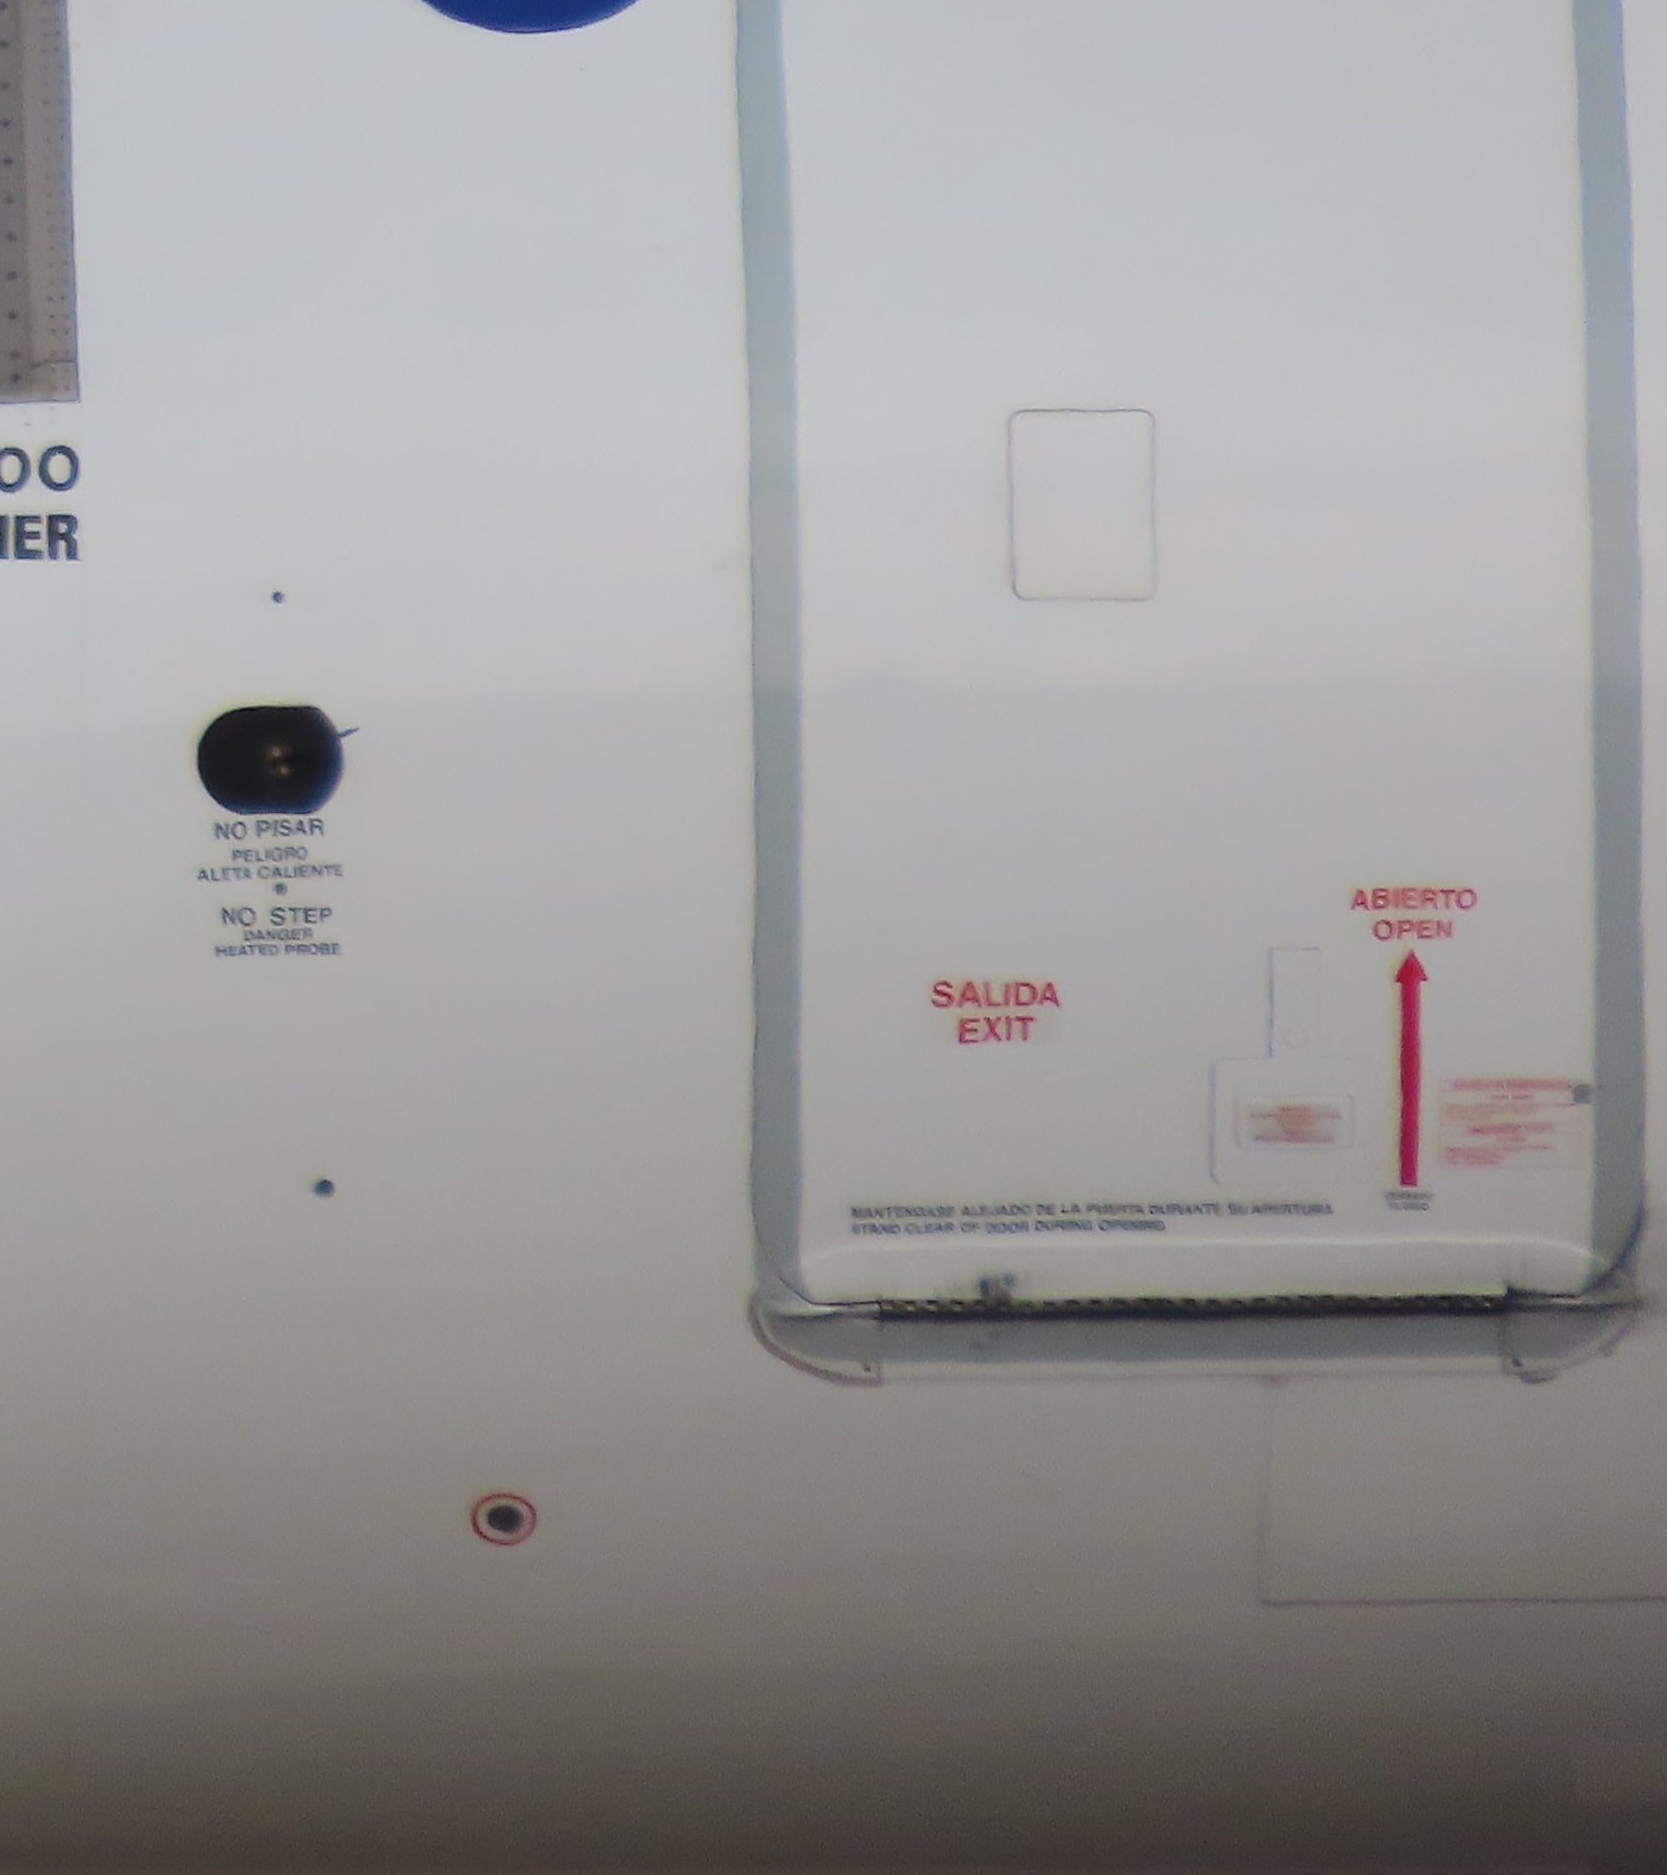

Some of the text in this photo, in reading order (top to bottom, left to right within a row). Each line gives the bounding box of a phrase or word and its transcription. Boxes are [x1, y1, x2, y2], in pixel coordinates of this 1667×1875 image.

[214, 818, 324, 840] NO PISAR
[232, 847, 308, 862] PELIGRO
[197, 864, 344, 882] ALETA CALIENTE
[1351, 888, 1477, 910] ABIERTO
[221, 907, 332, 926] NO STEP
[244, 928, 313, 941] DANGER
[1372, 919, 1453, 940] OPEN
[215, 943, 341, 957] HEATED PROBE
[931, 980, 1060, 1008] SALIDA
[958, 1015, 1035, 1044] EXIT
